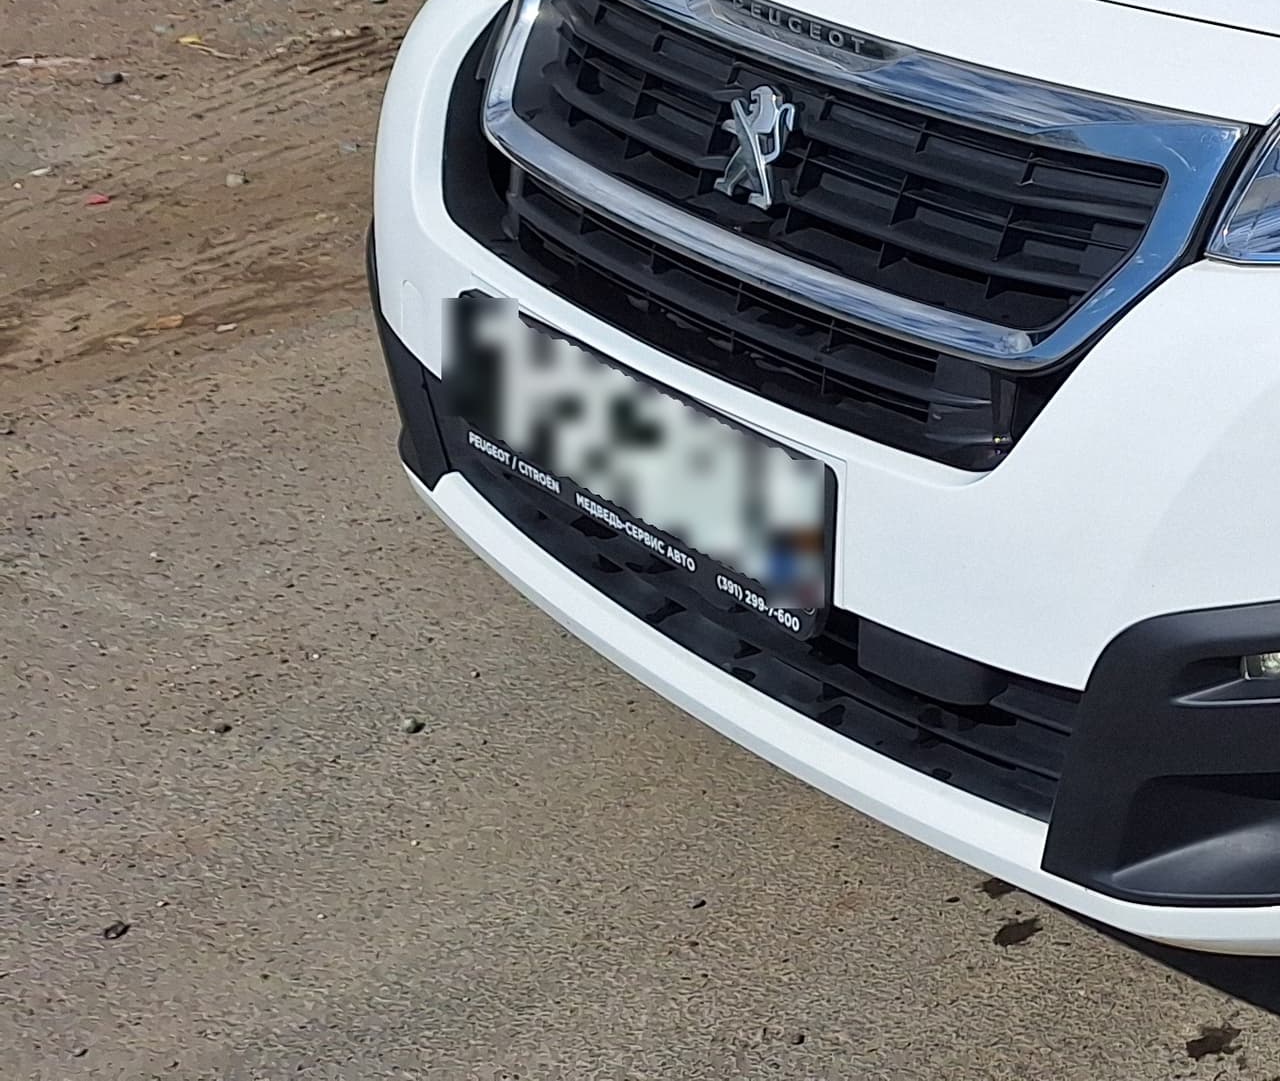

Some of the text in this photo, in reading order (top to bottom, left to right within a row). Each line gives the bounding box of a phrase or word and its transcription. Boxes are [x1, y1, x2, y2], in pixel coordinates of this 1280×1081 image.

[468, 431, 511, 466] PEUGEOT
[575, 492, 697, 572] МЕДВЕДЬ-СЕРВИС АВТО
[716, 575, 744, 602] (391)
